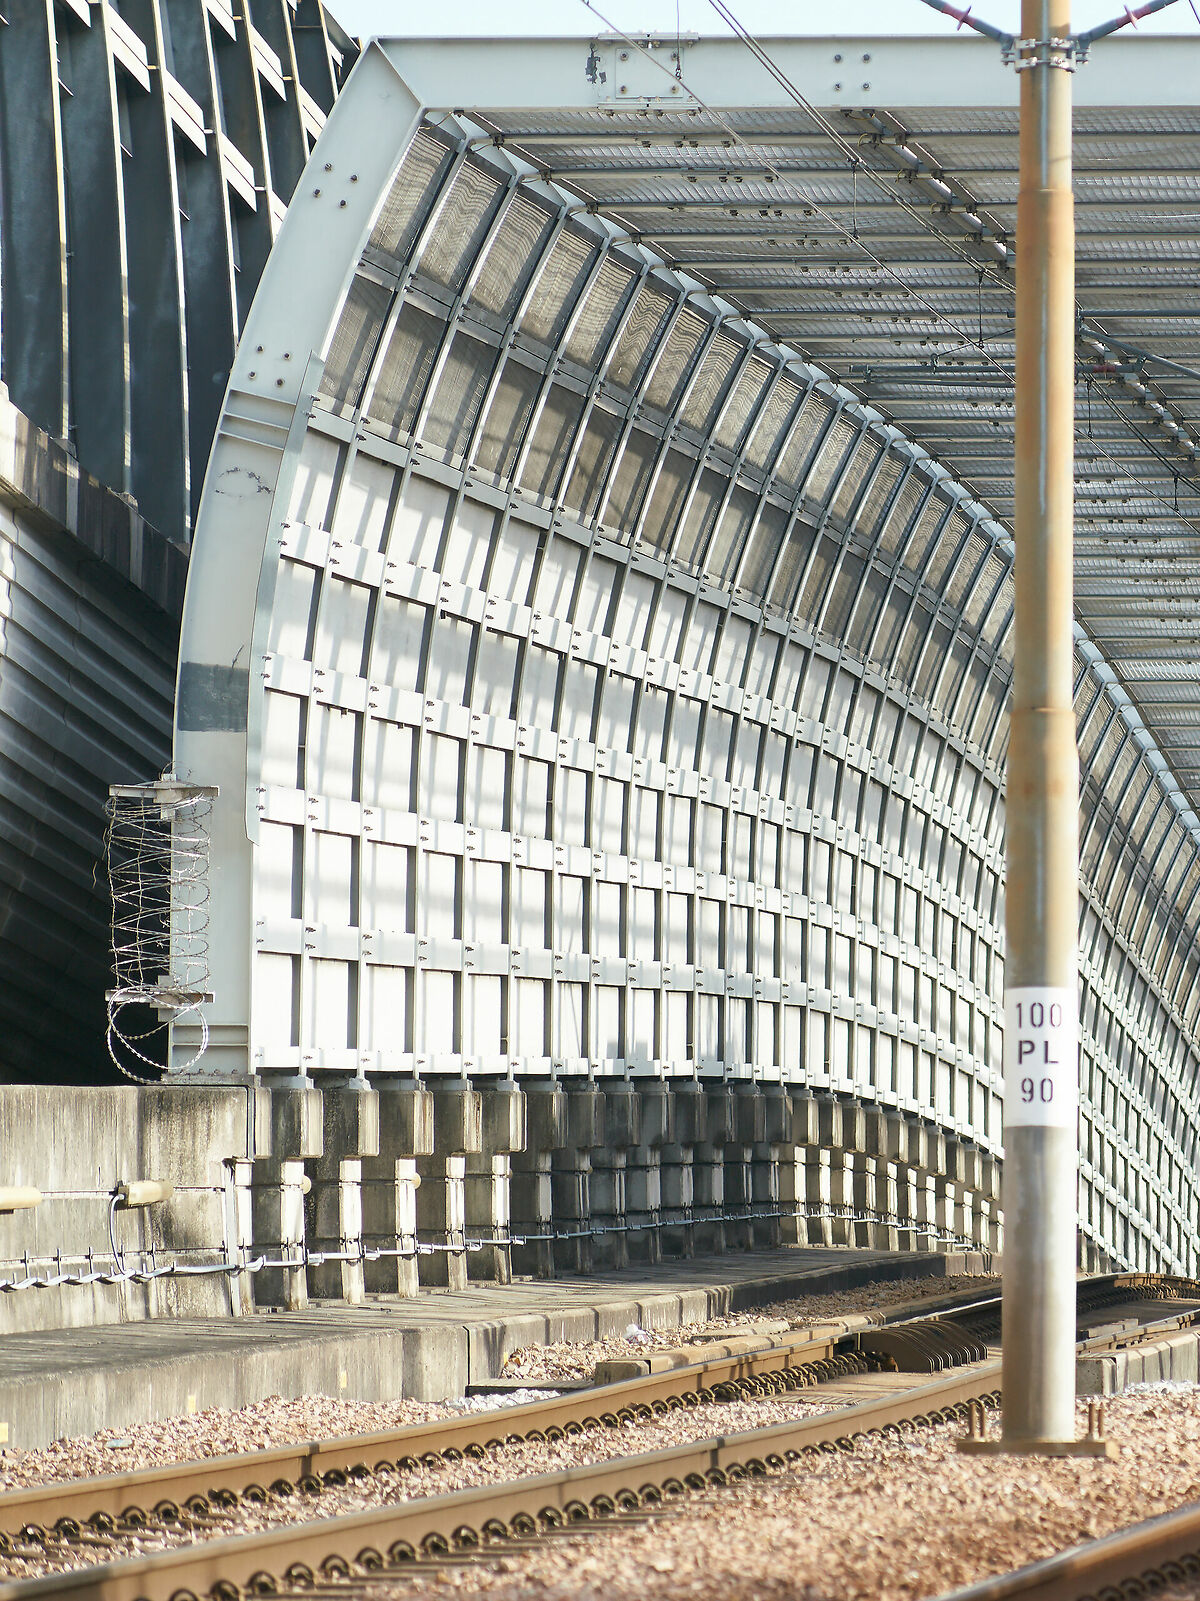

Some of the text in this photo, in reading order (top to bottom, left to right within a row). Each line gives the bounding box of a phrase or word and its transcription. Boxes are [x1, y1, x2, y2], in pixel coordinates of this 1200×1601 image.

[1016, 1002, 1062, 1029] 100
[1018, 1040, 1059, 1065] PL
[1021, 1077, 1054, 1103] 90
